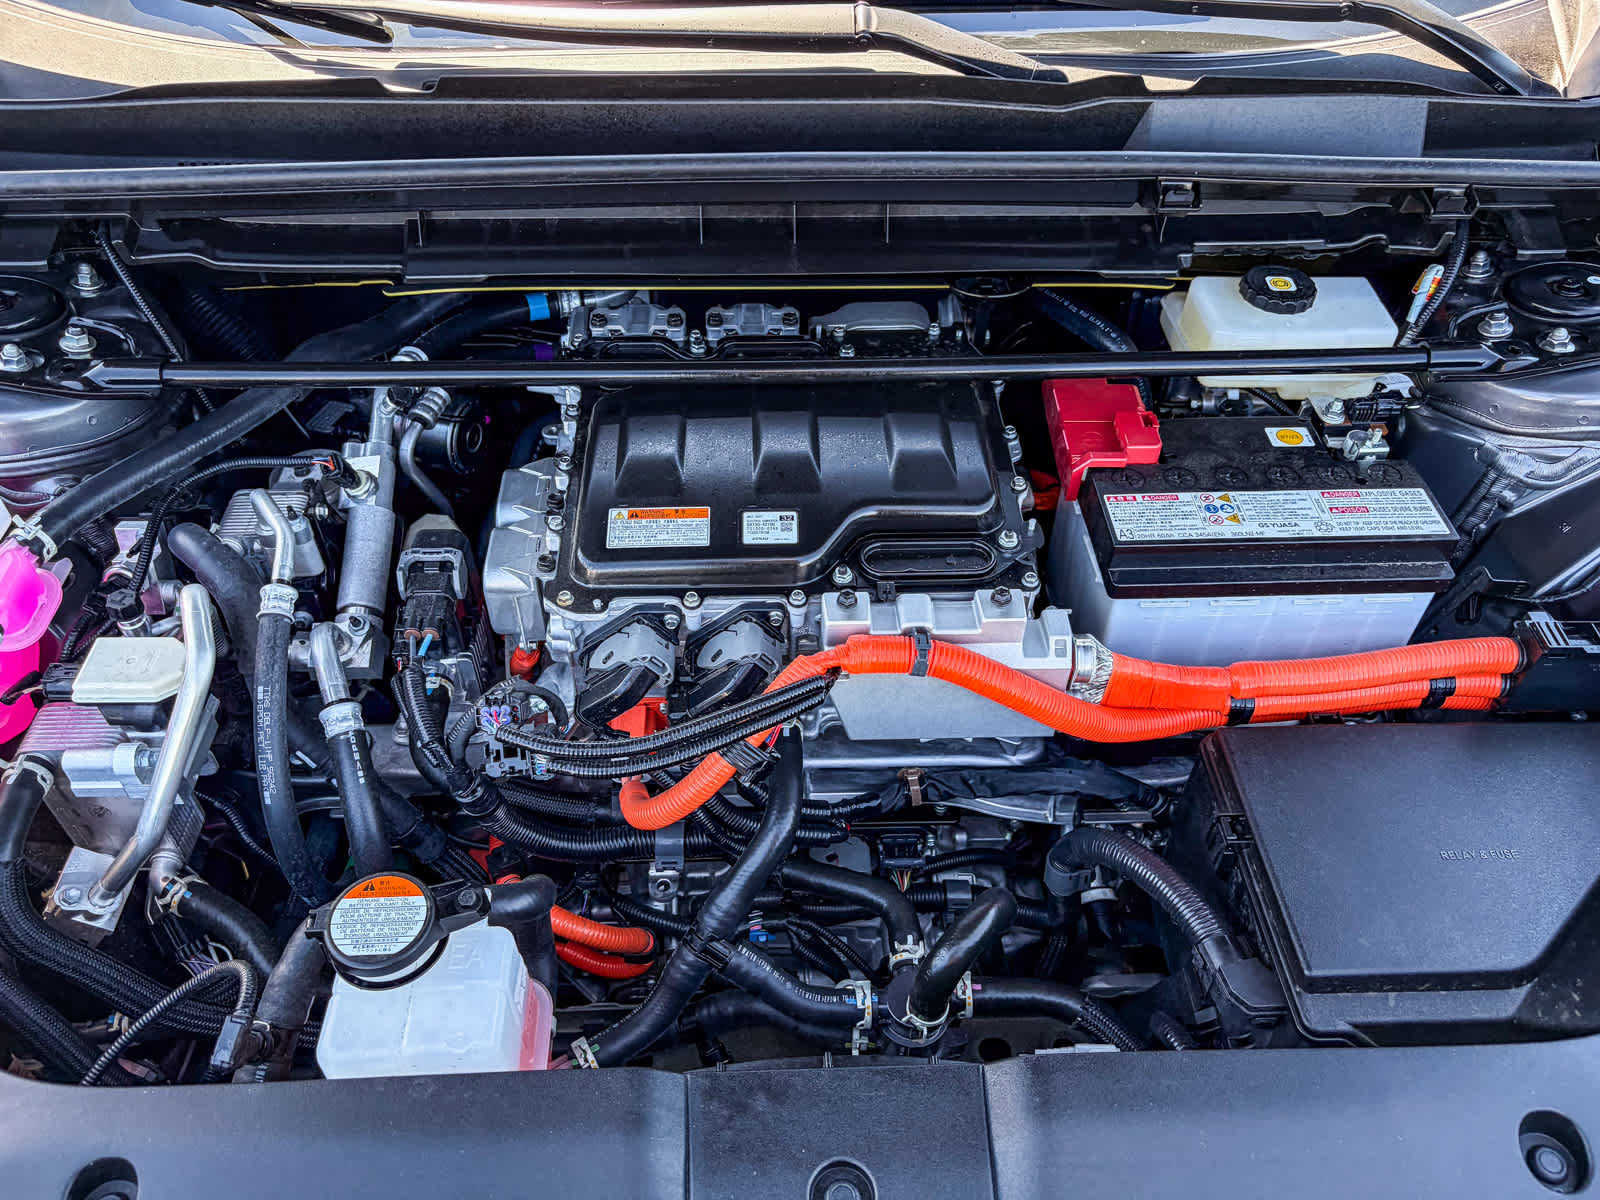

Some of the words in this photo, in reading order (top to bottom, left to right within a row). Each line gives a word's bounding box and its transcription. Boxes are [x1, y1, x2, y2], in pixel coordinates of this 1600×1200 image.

[1119, 528, 1135, 540] A3
[1440, 848, 1475, 860] RELAY
[1479, 849, 1488, 859] &
[1489, 848, 1521, 860] FUSE
